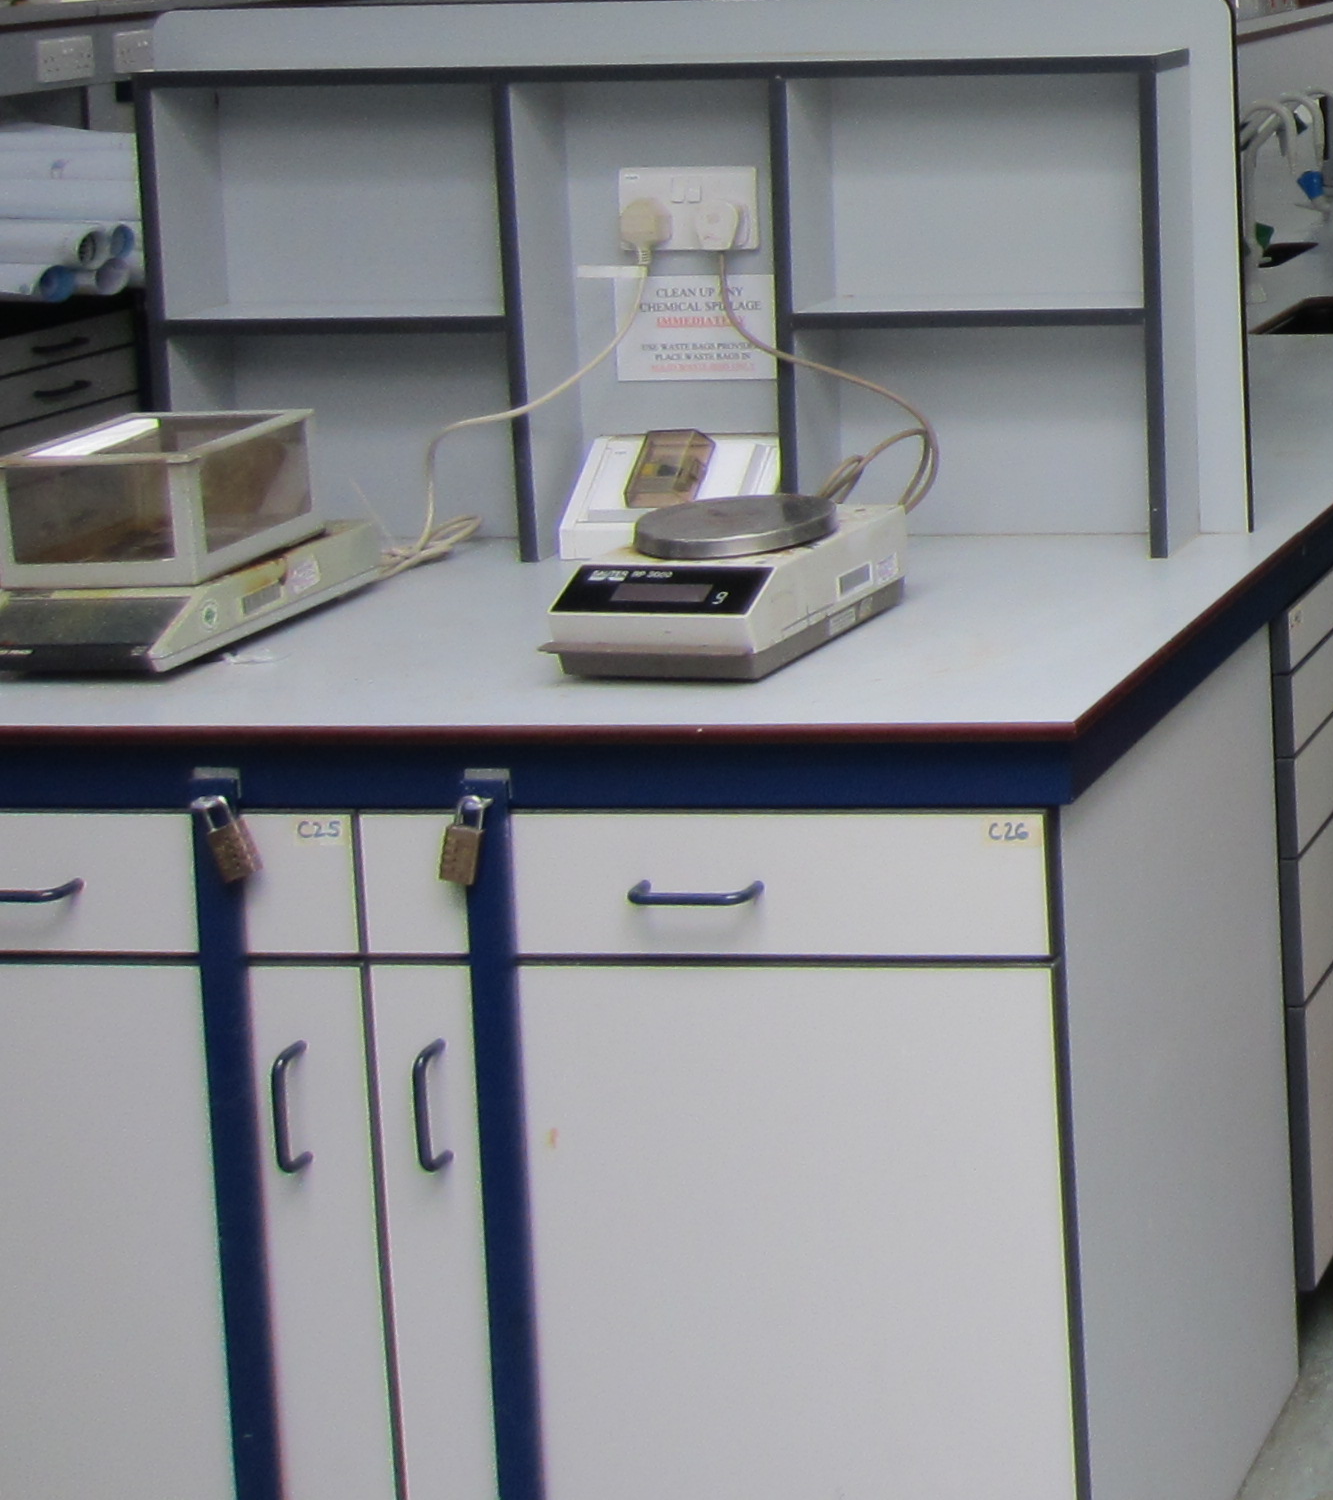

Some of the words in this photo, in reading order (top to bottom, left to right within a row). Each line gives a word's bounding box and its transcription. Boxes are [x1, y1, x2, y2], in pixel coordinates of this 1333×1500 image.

[656, 287, 696, 298] CLEAN
[699, 286, 715, 298] UP
[719, 286, 744, 298] NY
[639, 301, 703, 312] CHEMICAL
[656, 315, 746, 328] IMMEDIATEY
[661, 343, 689, 351] WASTE
[717, 342, 757, 350] PROVIDE
[712, 591, 729, 605] g
[297, 820, 341, 838] C25
[988, 821, 1030, 840] C26
